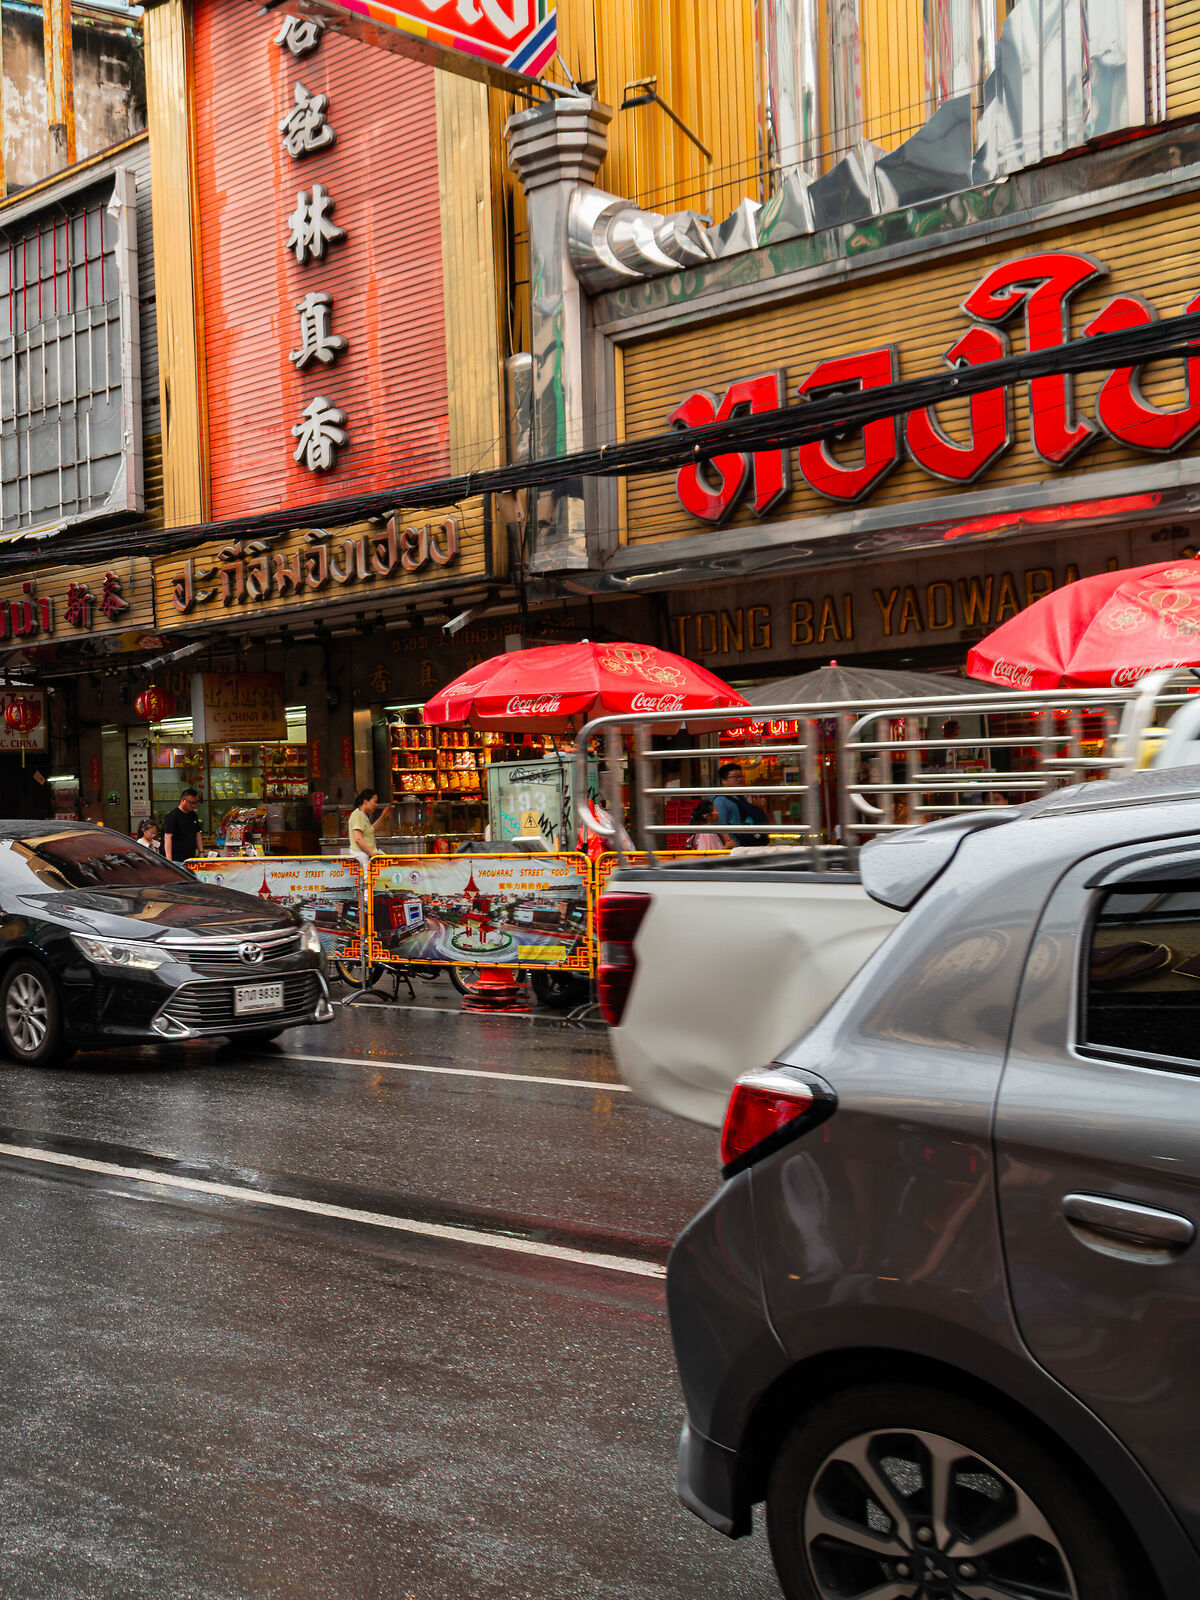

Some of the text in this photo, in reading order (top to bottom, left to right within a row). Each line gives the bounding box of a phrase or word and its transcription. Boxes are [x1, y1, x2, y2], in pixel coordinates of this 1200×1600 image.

[673, 605, 773, 658] TONG
[788, 592, 855, 648] BAI
[270, 871, 300, 879] YAOWARAJ
[329, 870, 345, 878] FOOD
[478, 868, 570, 878] YAOWARAJ STREET FOOD
